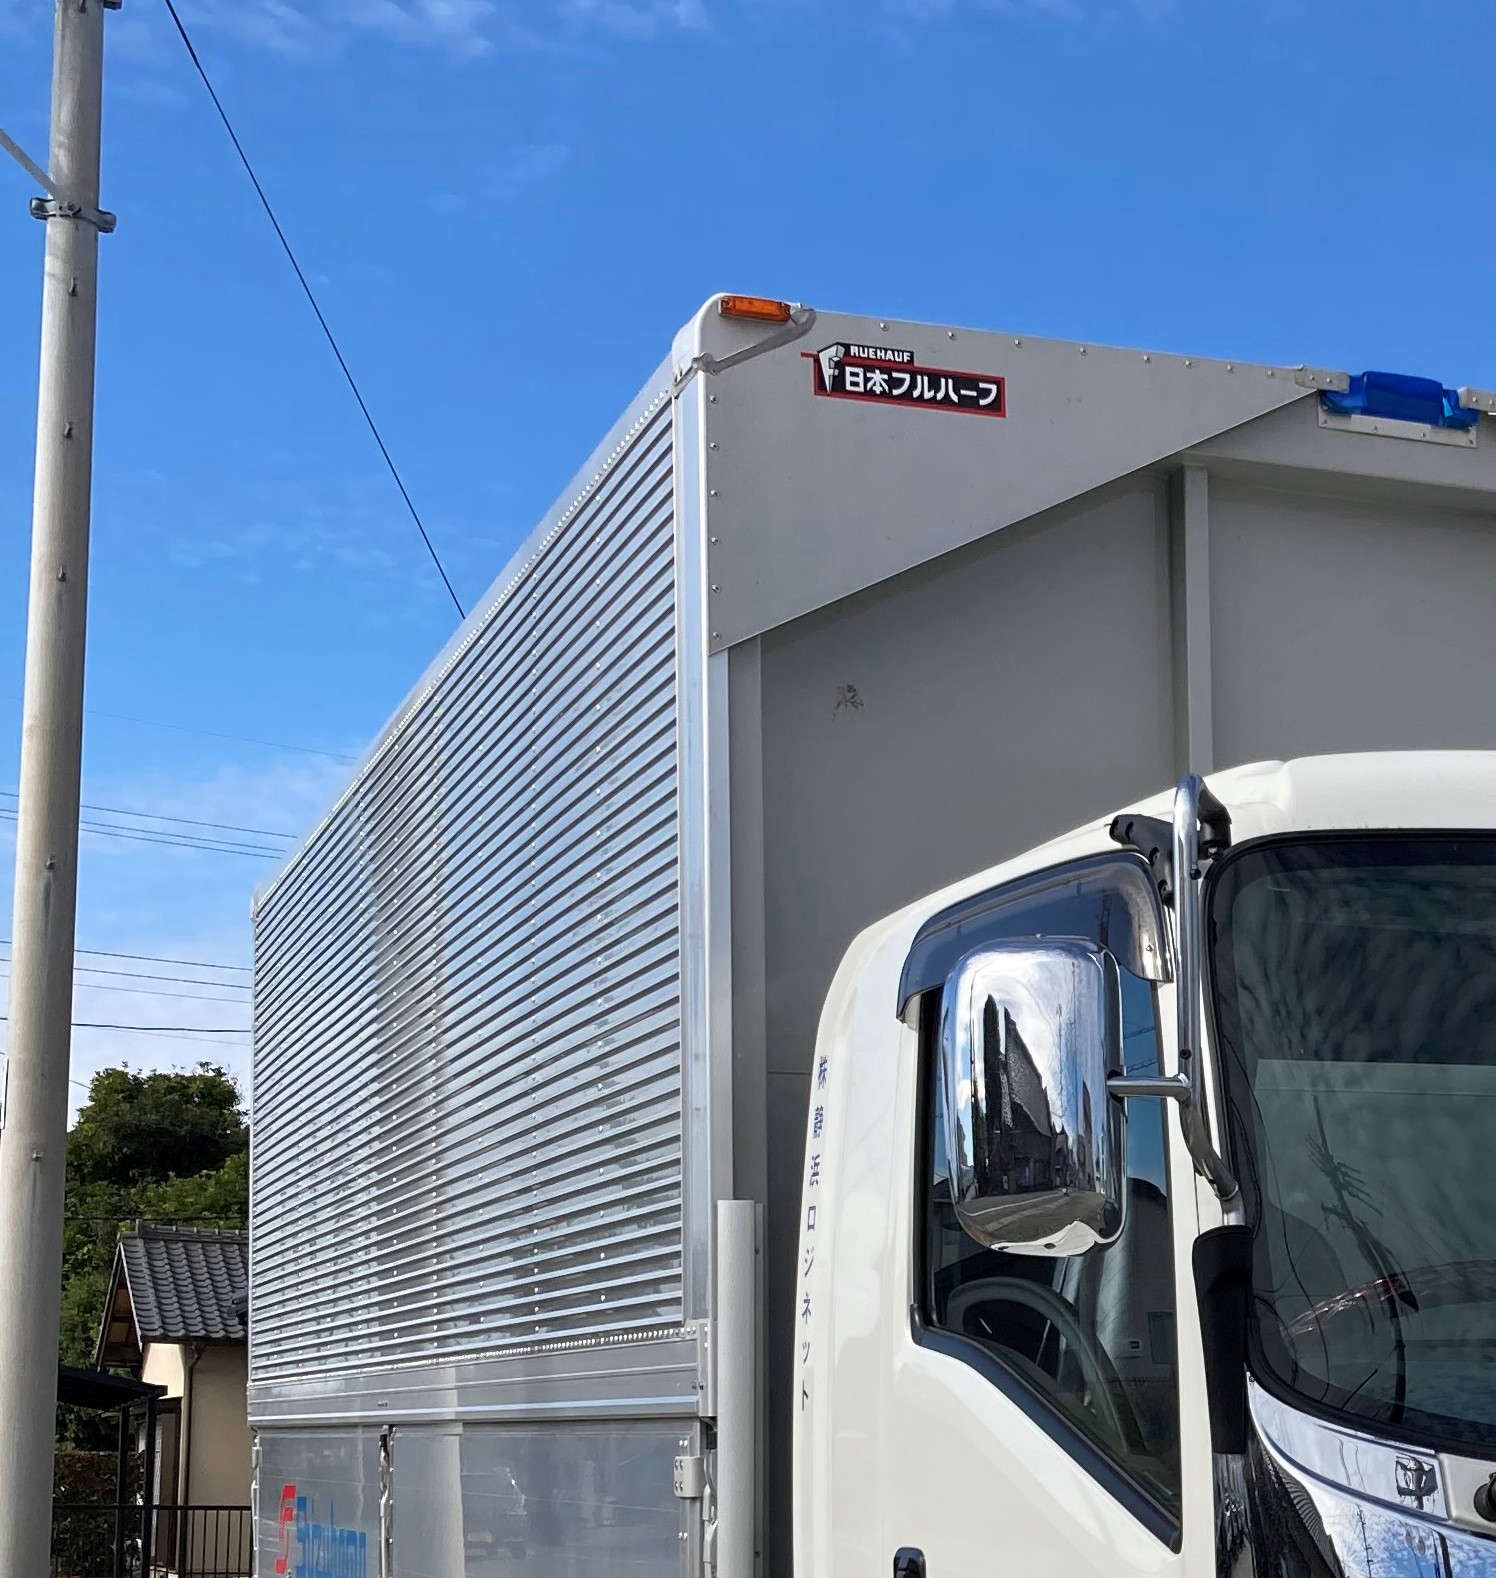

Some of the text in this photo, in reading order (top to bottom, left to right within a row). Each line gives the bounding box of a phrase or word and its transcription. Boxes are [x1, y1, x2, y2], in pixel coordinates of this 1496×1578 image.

[845, 366, 998, 406] 日本フルハーフ
